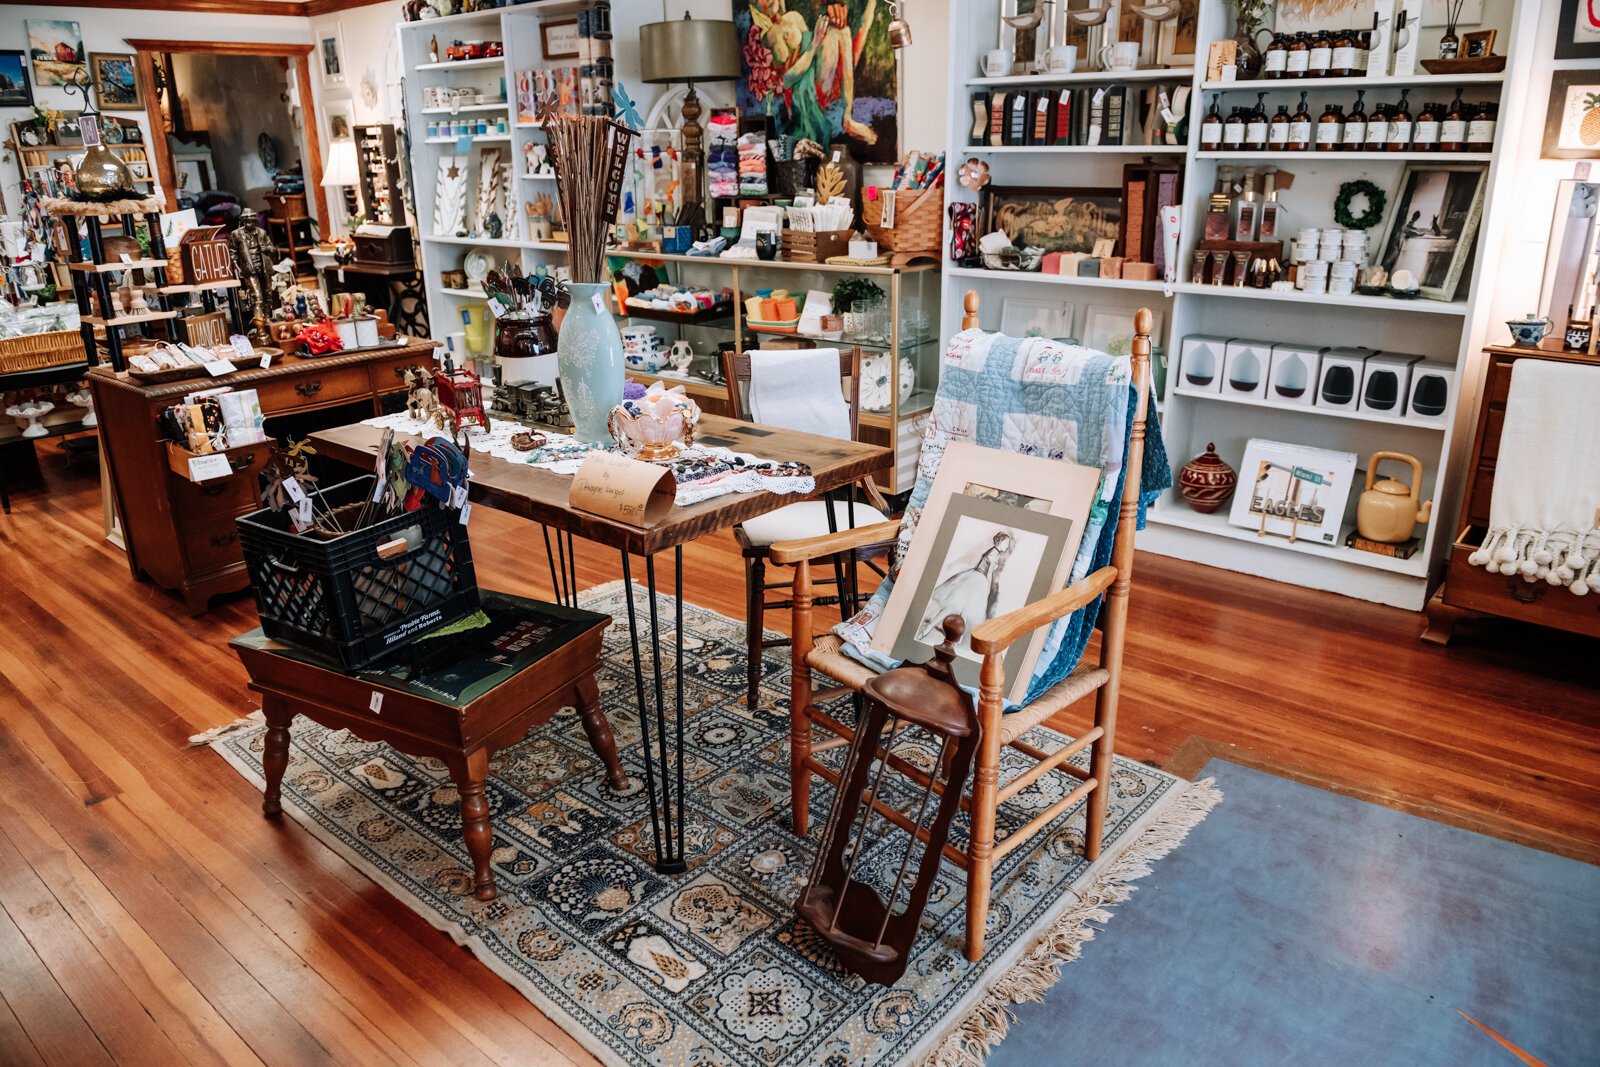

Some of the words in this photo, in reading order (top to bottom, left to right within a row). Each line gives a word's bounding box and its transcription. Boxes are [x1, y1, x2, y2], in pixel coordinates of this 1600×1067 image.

[606, 131, 628, 216] WELCOME
[191, 242, 233, 281] GATHER
[1295, 469, 1313, 481] Miami
[1250, 495, 1326, 522] EAGLES
[386, 630, 406, 645] Hiland
[408, 625, 418, 634] and
[418, 615, 442, 629] Roberts
[400, 618, 420, 631] Prairie
